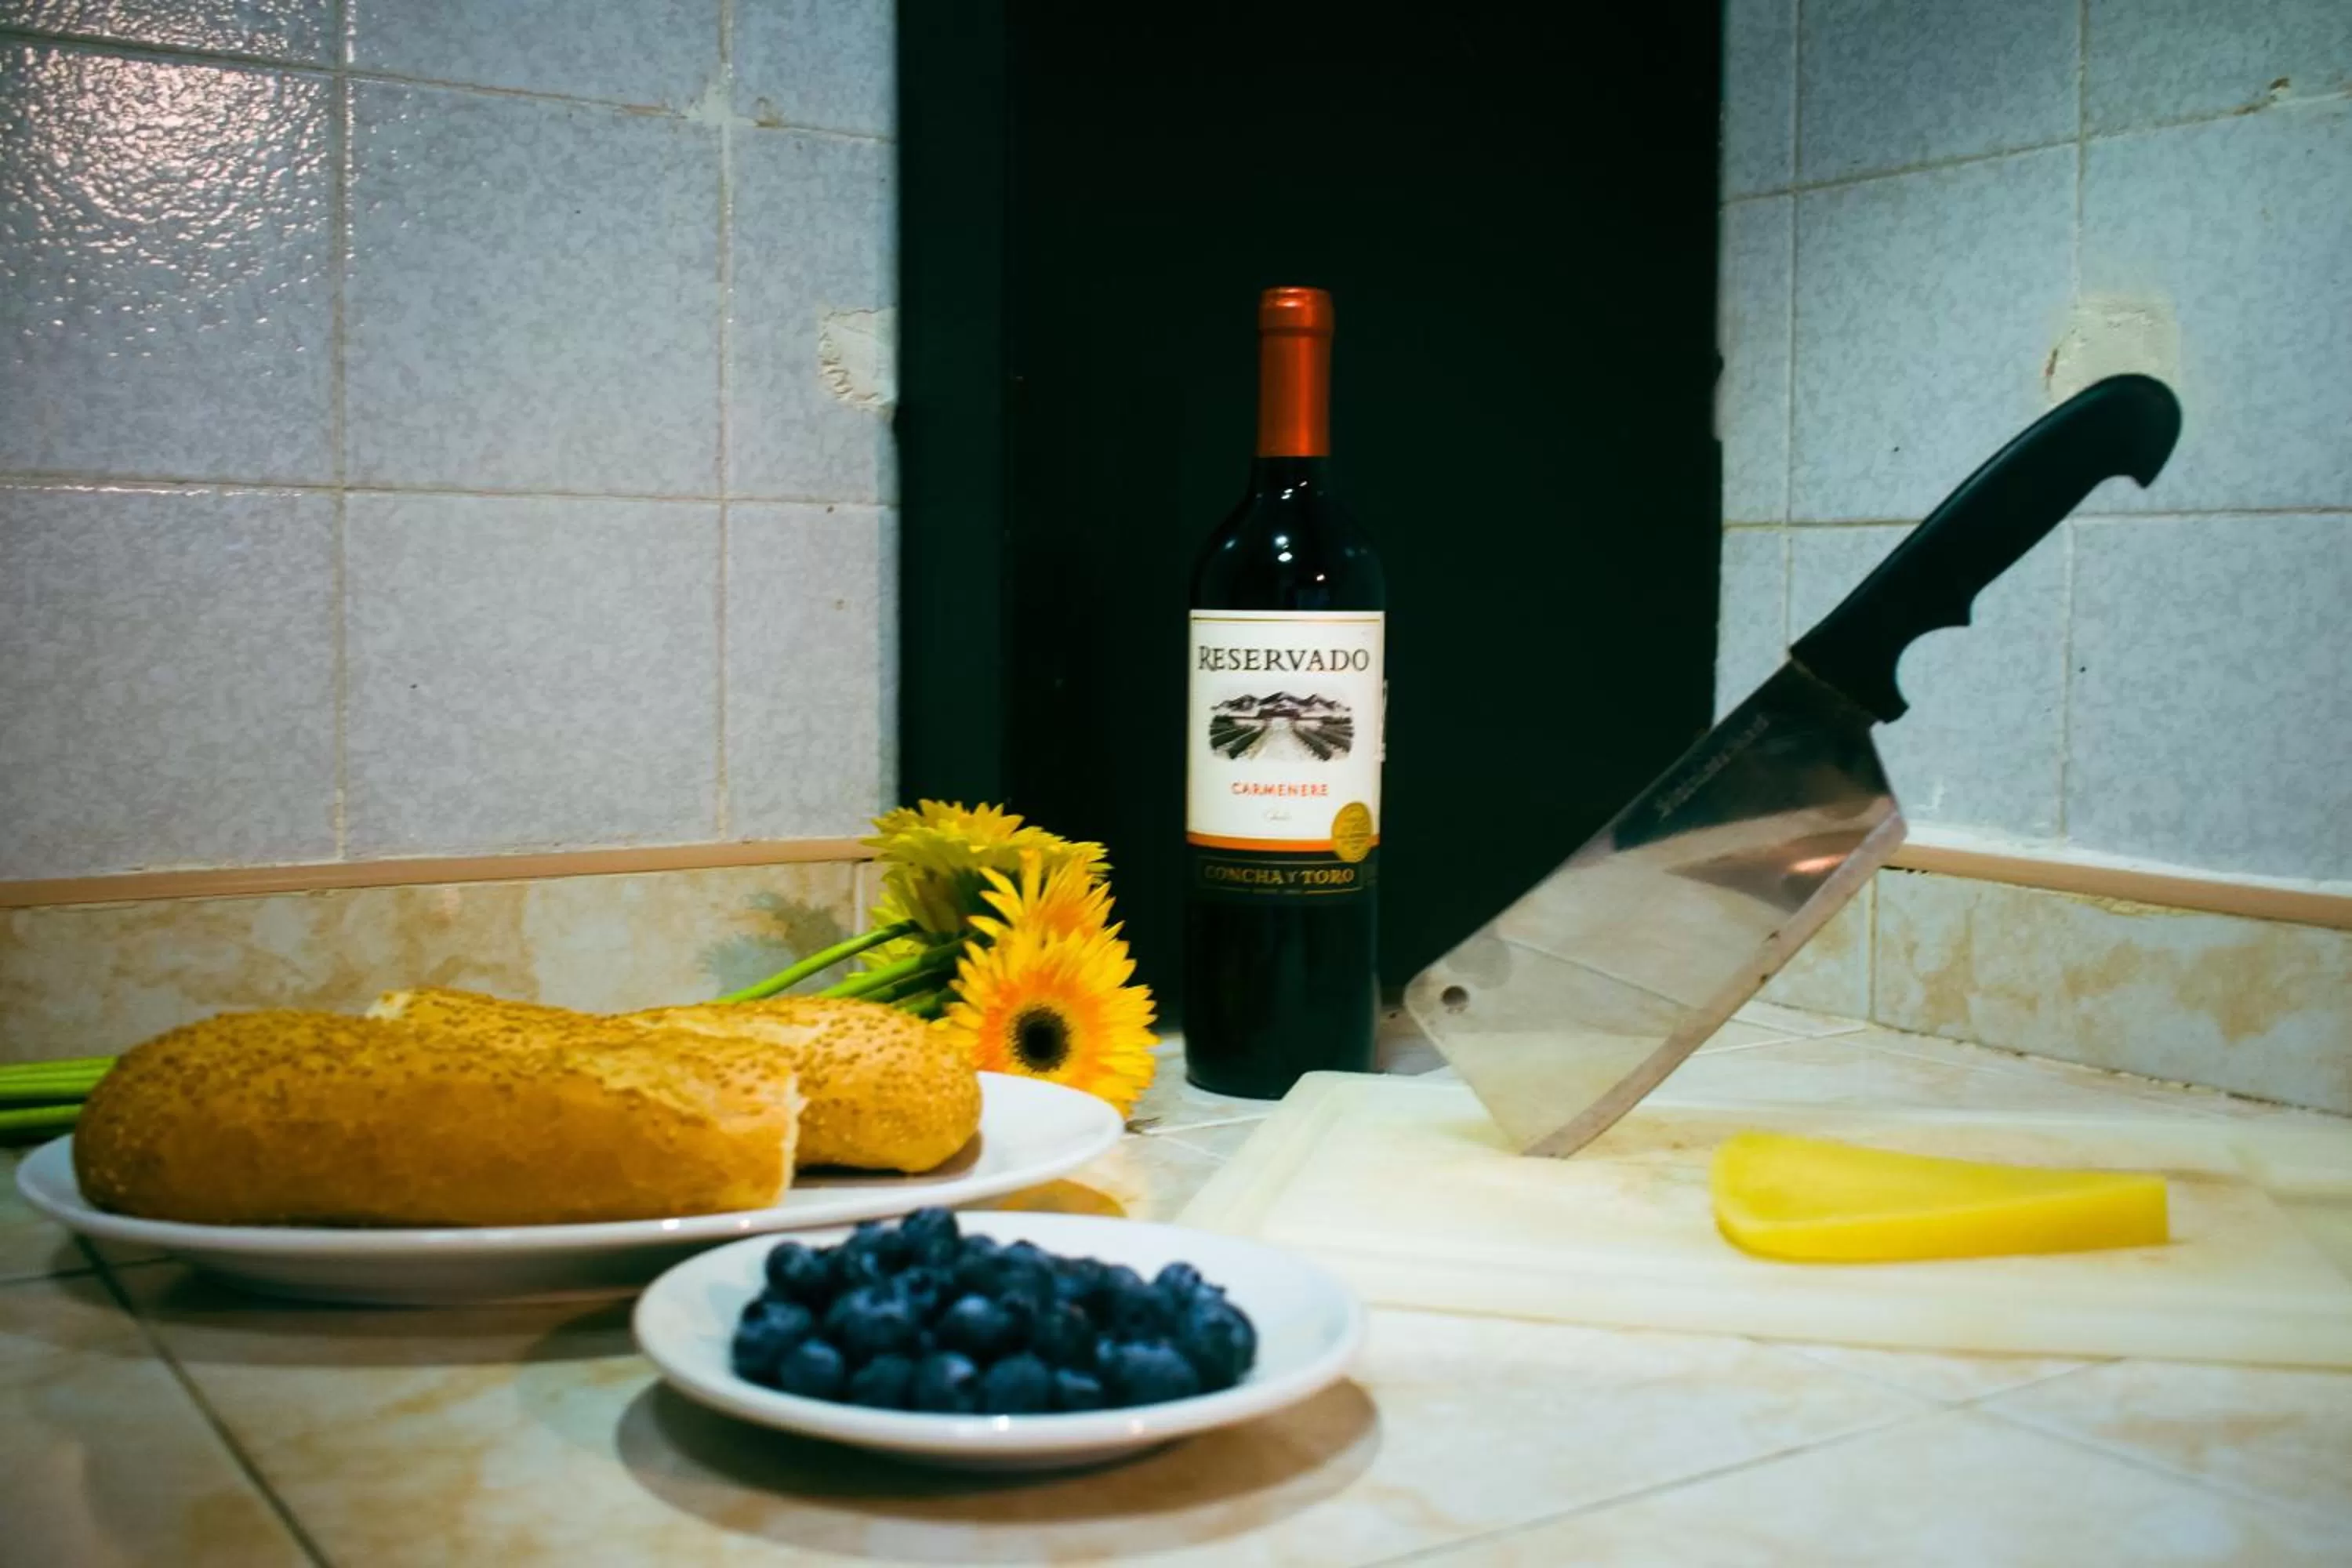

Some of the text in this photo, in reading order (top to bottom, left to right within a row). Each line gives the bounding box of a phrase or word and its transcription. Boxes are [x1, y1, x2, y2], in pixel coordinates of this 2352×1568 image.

[1198, 645, 1370, 672] RESERVADO
[1204, 865, 1283, 885] CONCHA
[1300, 868, 1356, 884] TORO
